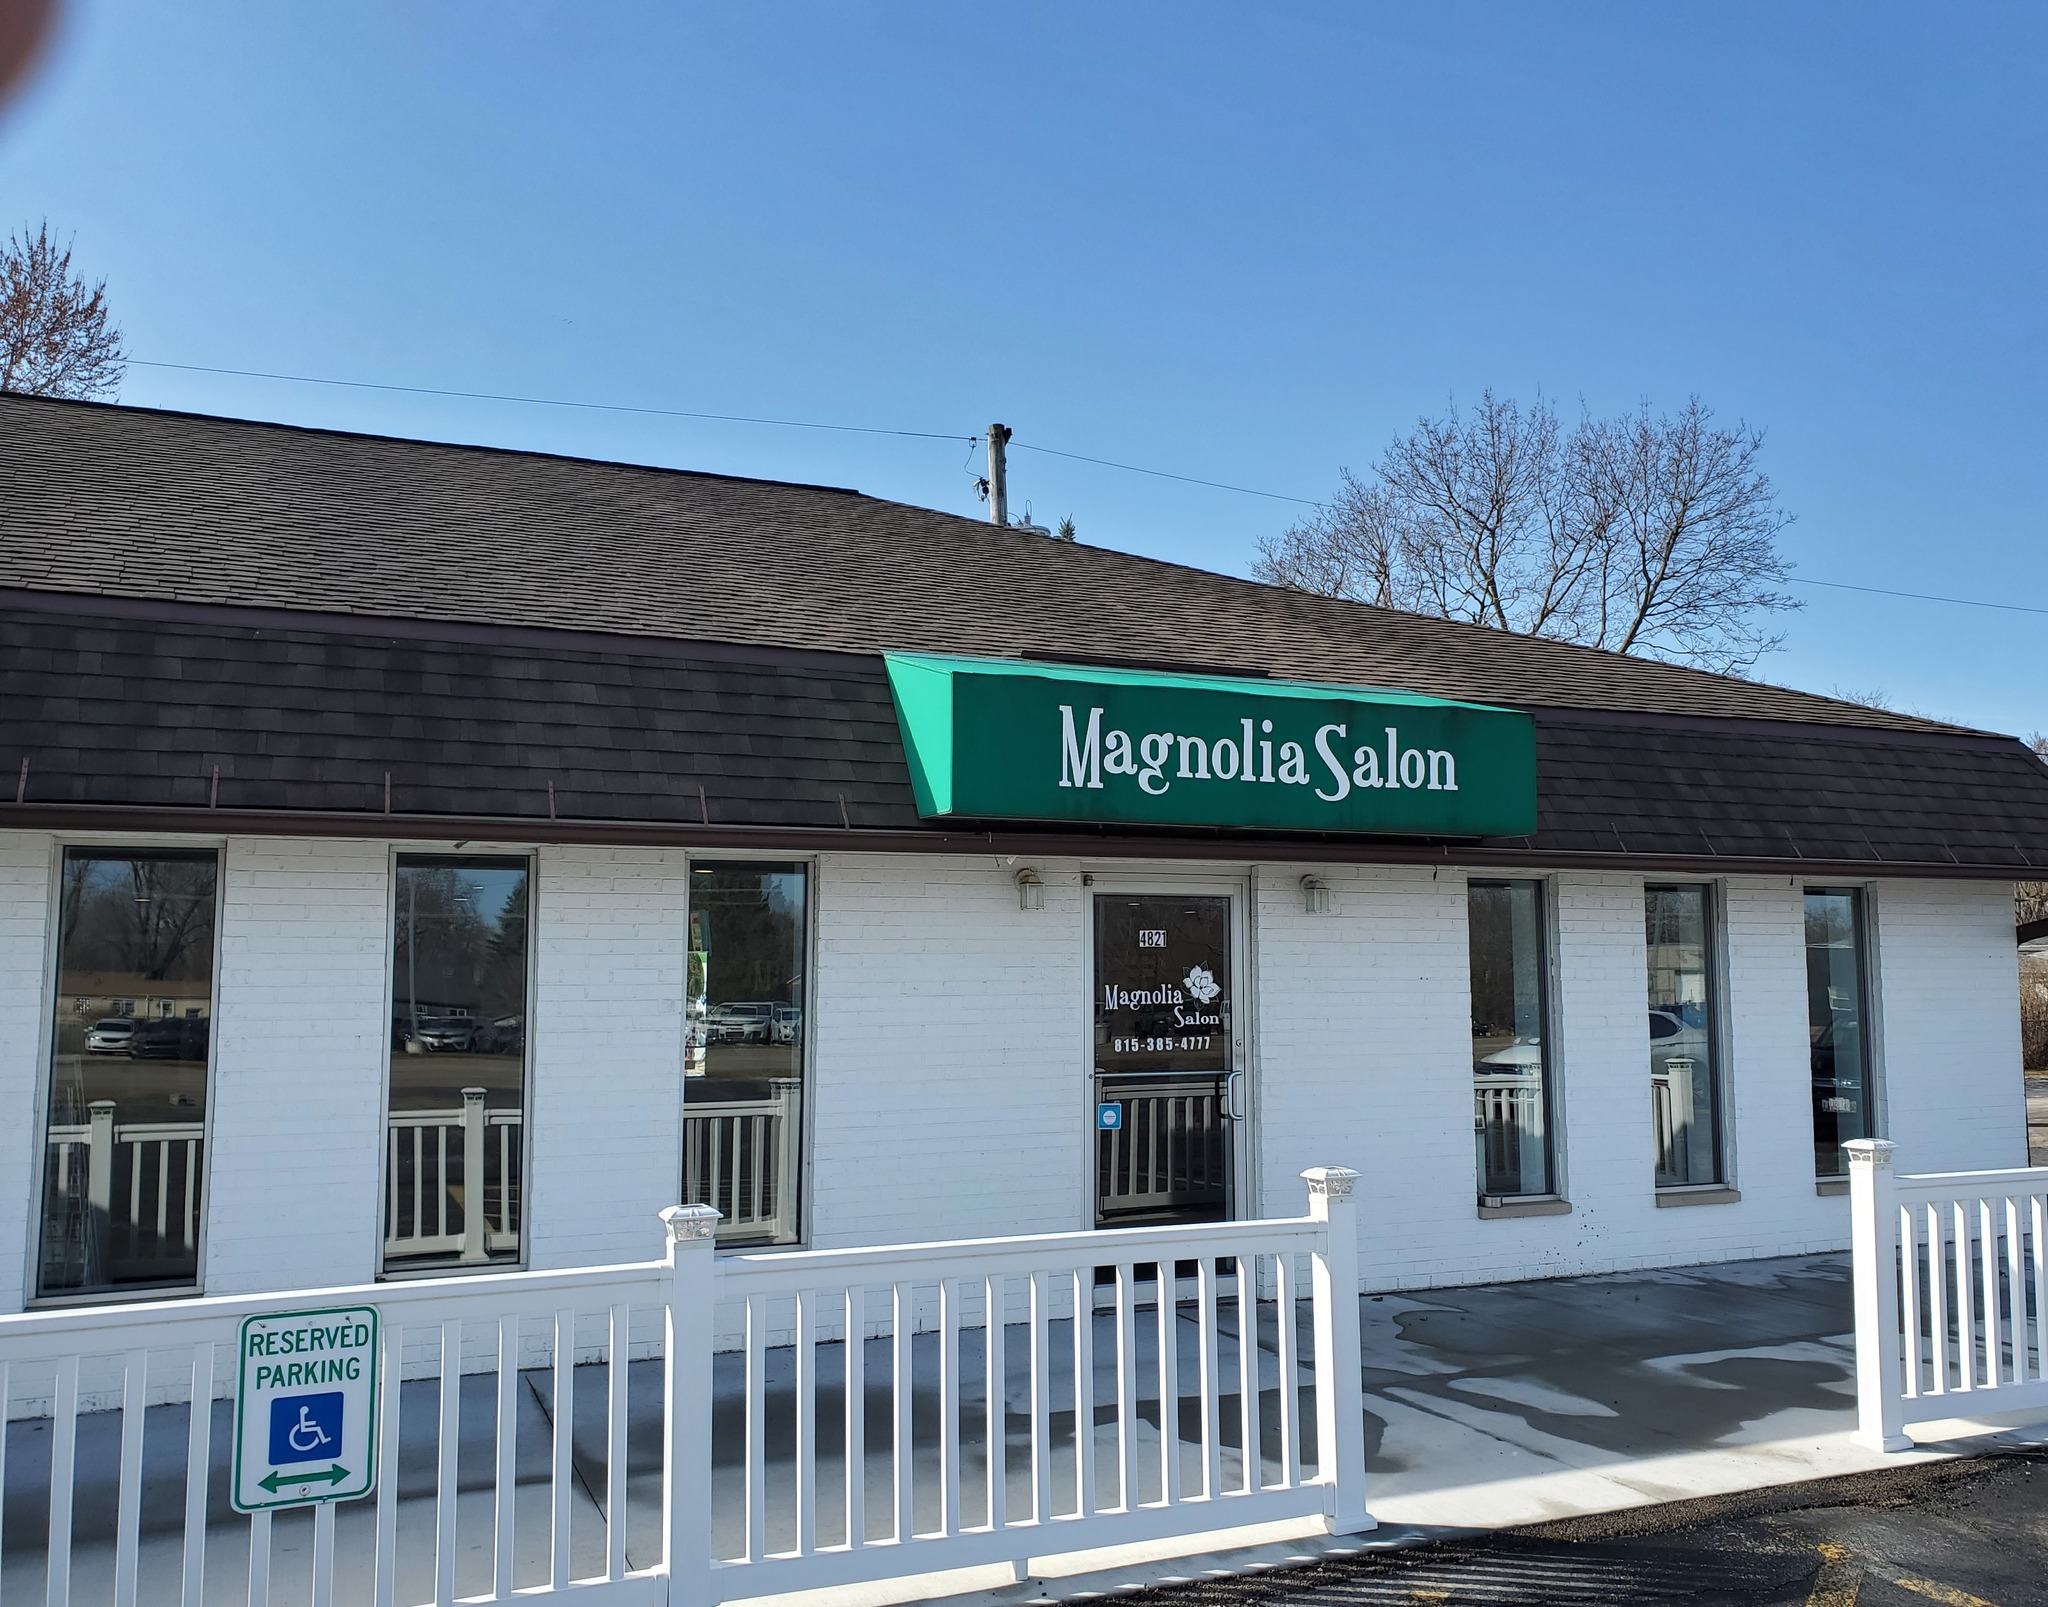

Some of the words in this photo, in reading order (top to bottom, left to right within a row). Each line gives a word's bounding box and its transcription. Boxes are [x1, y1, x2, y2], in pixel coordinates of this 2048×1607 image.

[1058, 704, 1310, 795] Magnolia
[1314, 723, 1459, 802] Salon
[1139, 931, 1166, 947] 4821
[1104, 984, 1184, 1010] Magnolia
[1174, 1005, 1220, 1028] Salon
[1114, 1036, 1211, 1053] 815-385-4777
[249, 1323, 369, 1357] RESERVED
[256, 1356, 361, 1390] PARKING
